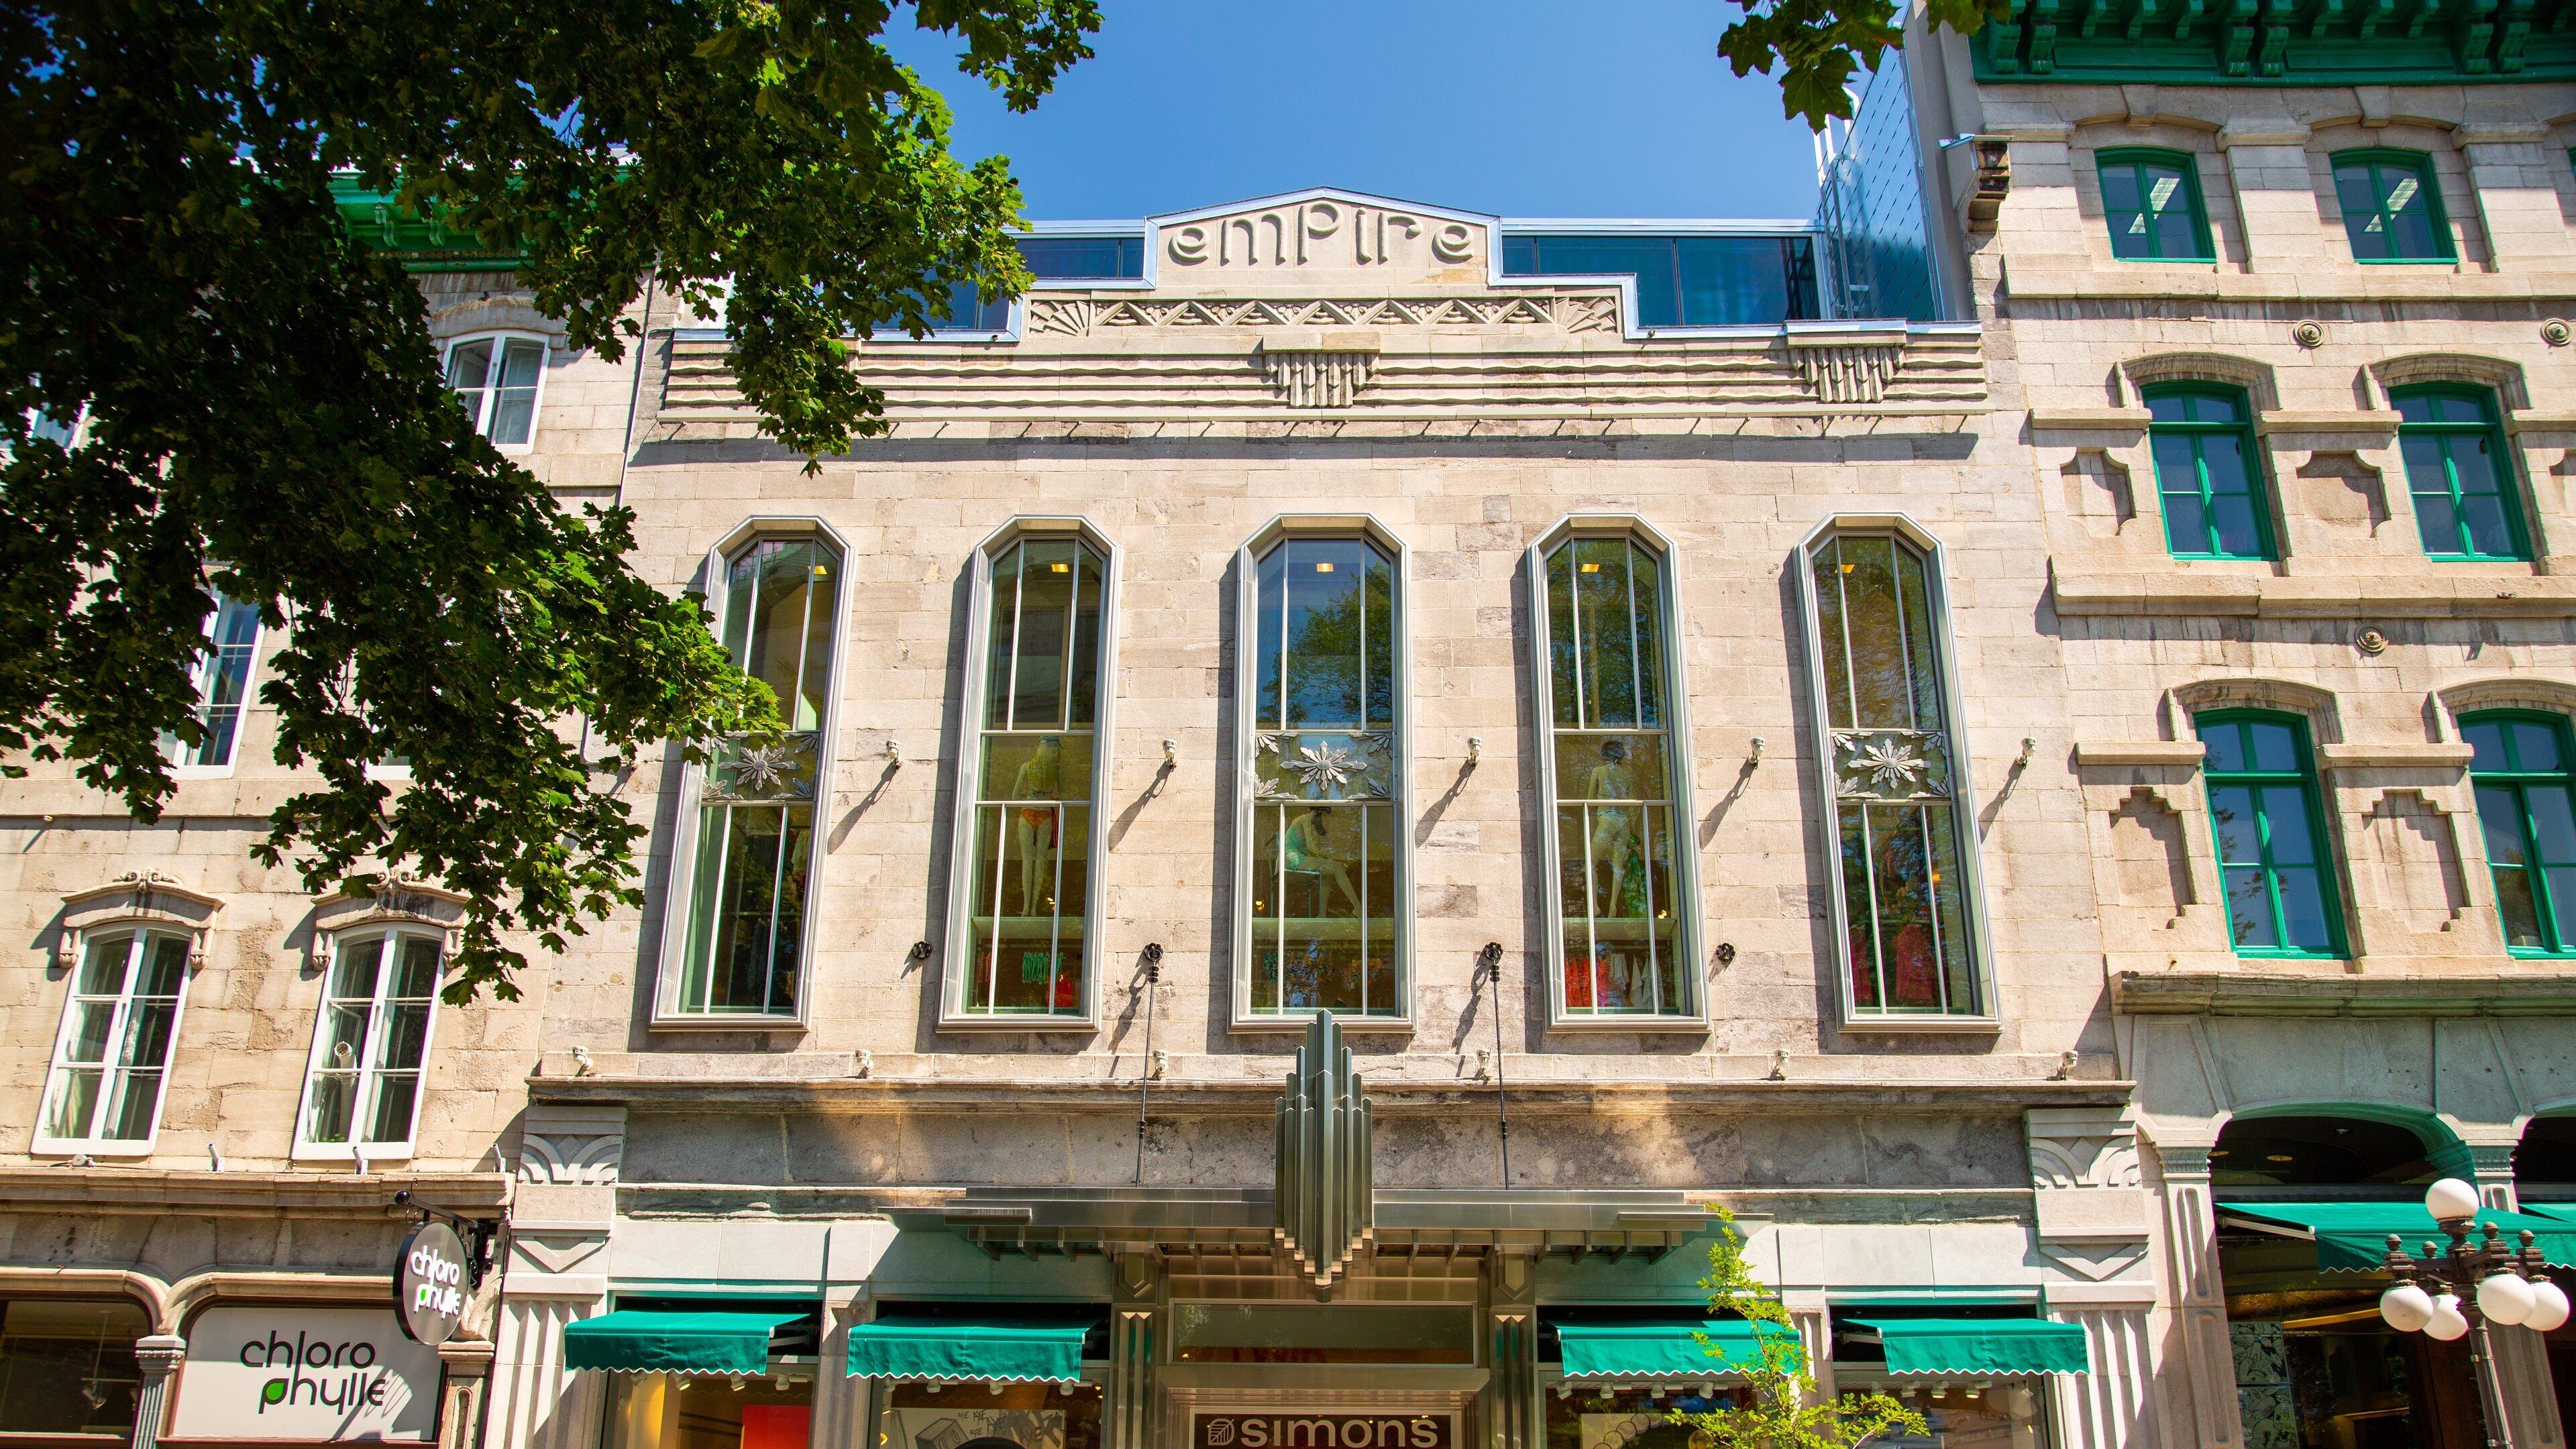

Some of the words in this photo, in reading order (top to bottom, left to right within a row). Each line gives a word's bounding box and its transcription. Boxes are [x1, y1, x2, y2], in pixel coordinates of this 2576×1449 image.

[1169, 201, 1474, 262] empire
[411, 1245, 460, 1285] chloro
[413, 1283, 461, 1319] phylle
[240, 1330, 376, 1369] chloro
[258, 1373, 386, 1415] phylle
[1241, 1418, 1438, 1448] simons
